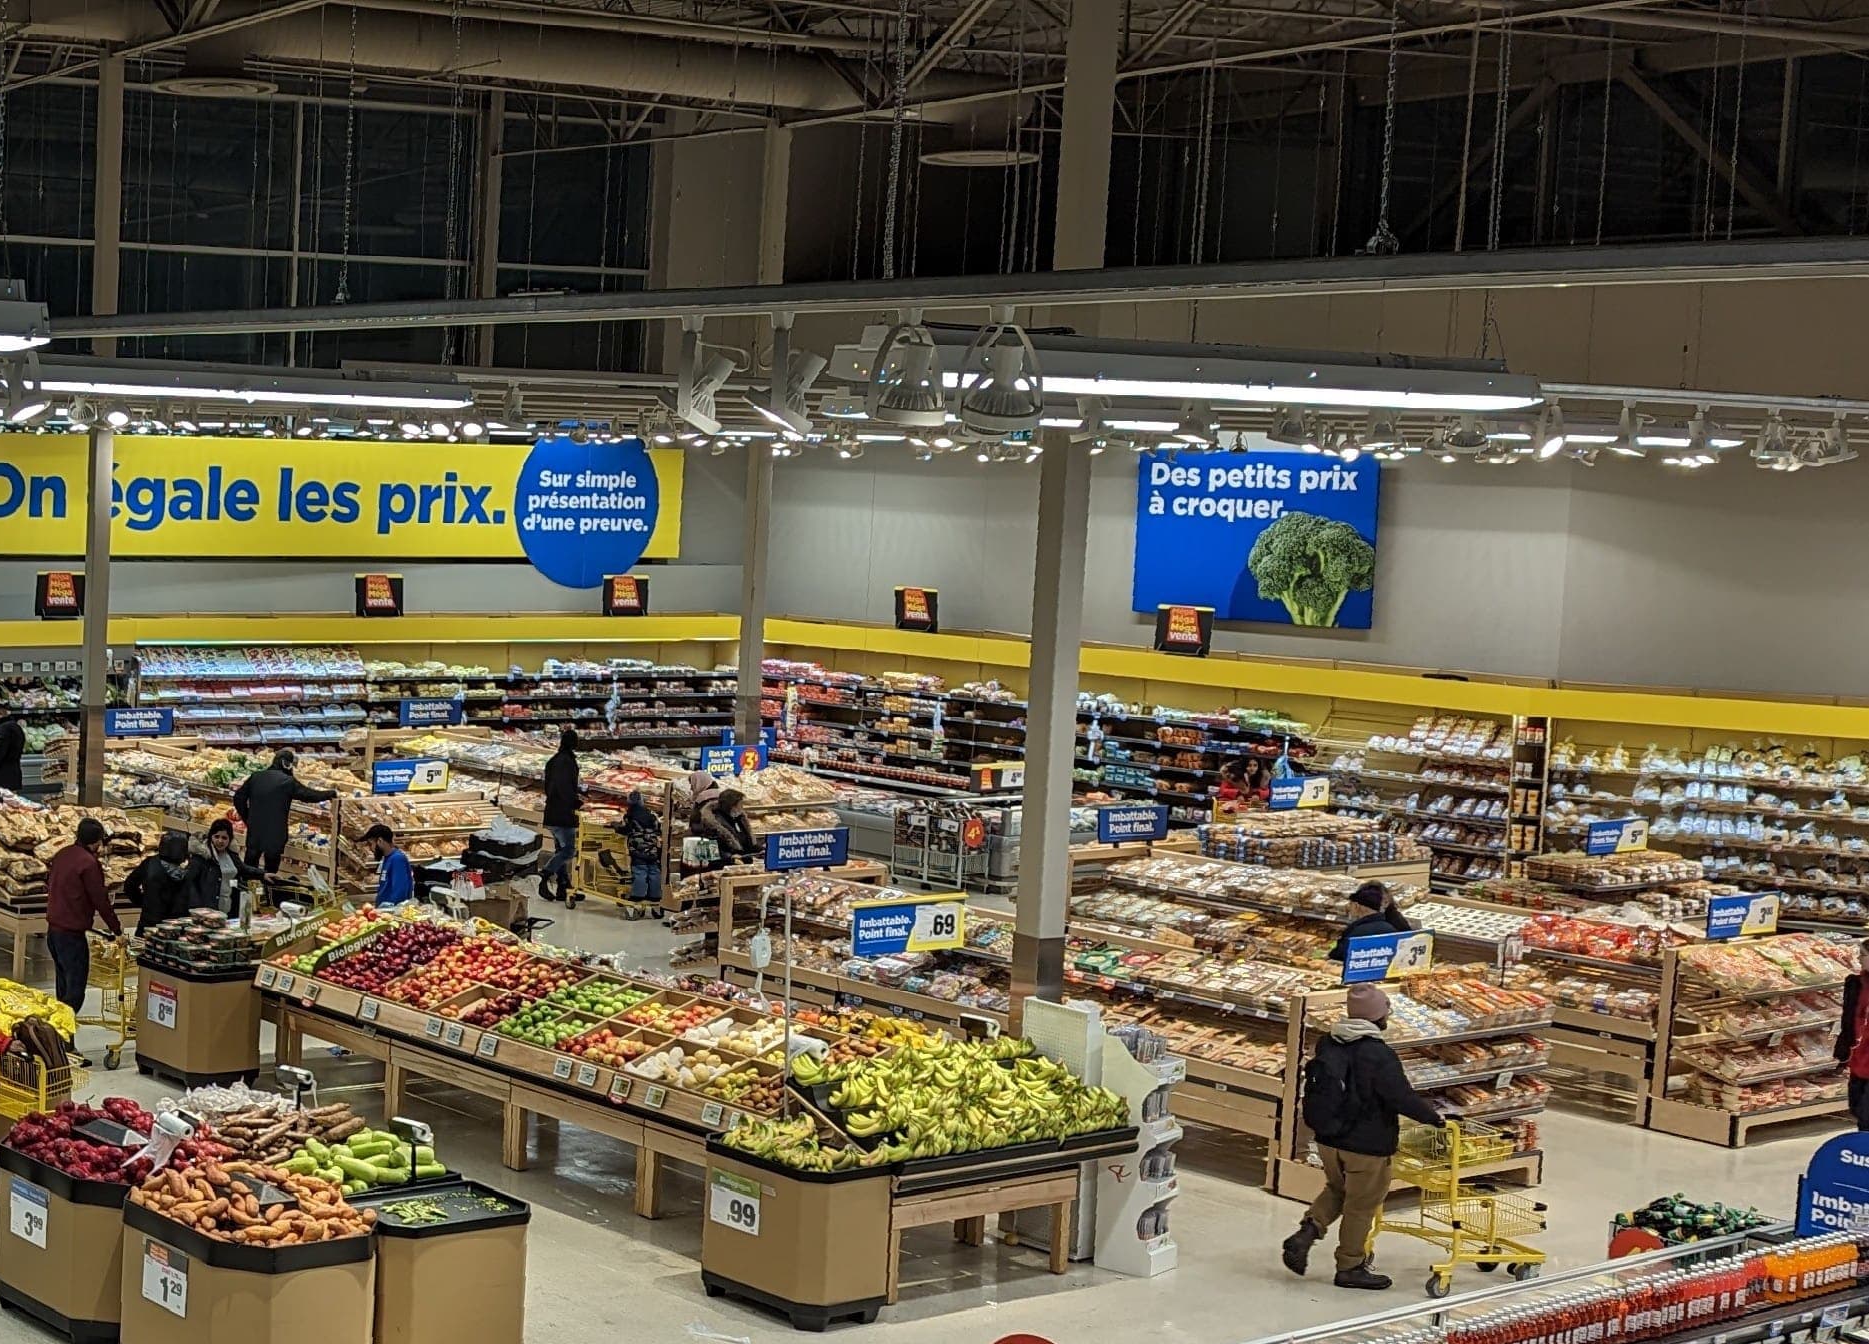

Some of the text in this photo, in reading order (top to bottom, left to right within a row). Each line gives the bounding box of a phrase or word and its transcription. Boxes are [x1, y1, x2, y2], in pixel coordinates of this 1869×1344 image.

[539, 470, 637, 491] Sur simple
[1151, 463, 1359, 494] Des petits prix
[277, 467, 361, 524] les
[377, 472, 505, 535] prix.
[528, 492, 646, 512] présentation
[1148, 490, 1289, 522] à croquer.
[522, 514, 649, 534] d'une preuve.
